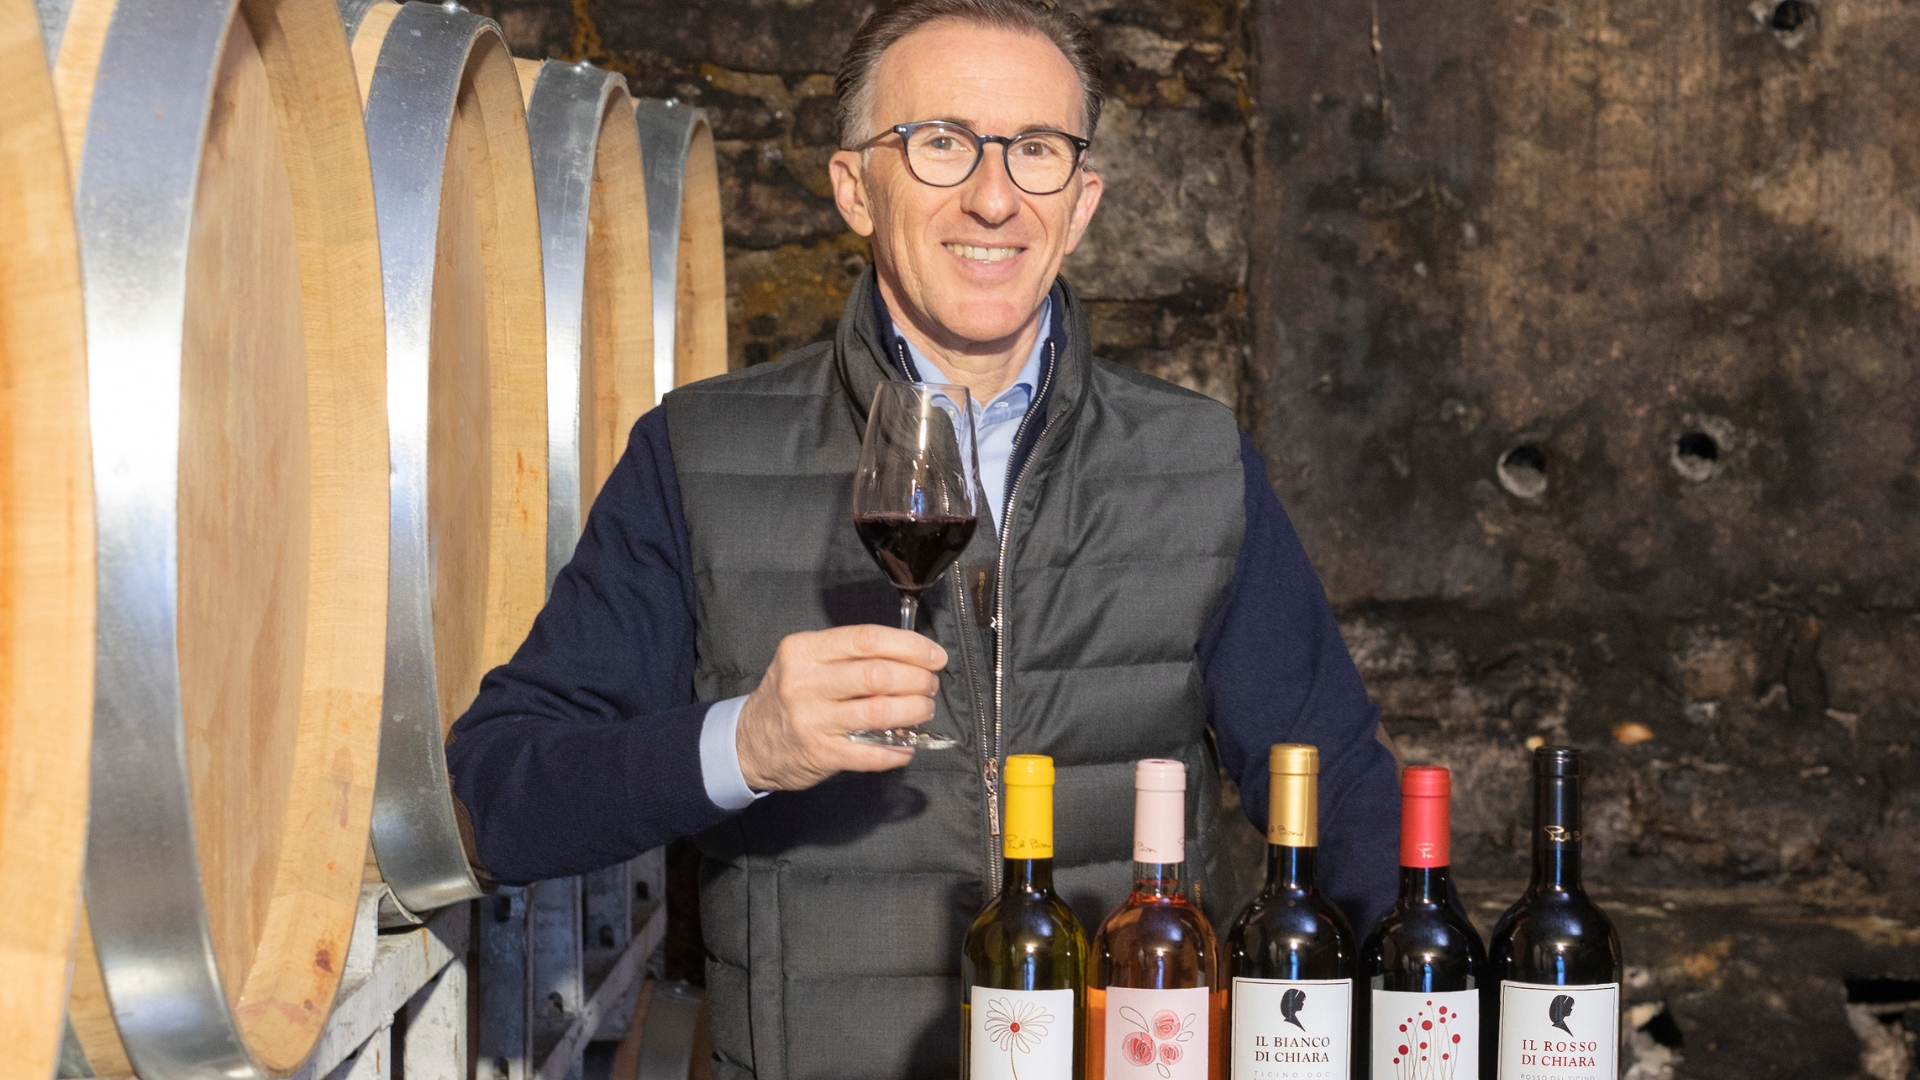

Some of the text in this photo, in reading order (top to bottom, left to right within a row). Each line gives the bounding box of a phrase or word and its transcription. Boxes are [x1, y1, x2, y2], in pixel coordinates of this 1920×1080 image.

[1256, 1036, 1330, 1047] IL BIANCO
[1522, 1039, 1597, 1052] IL ROSSO
[1255, 1051, 1329, 1062] DI CHIARA
[1521, 1054, 1595, 1067] DI CHIARA
